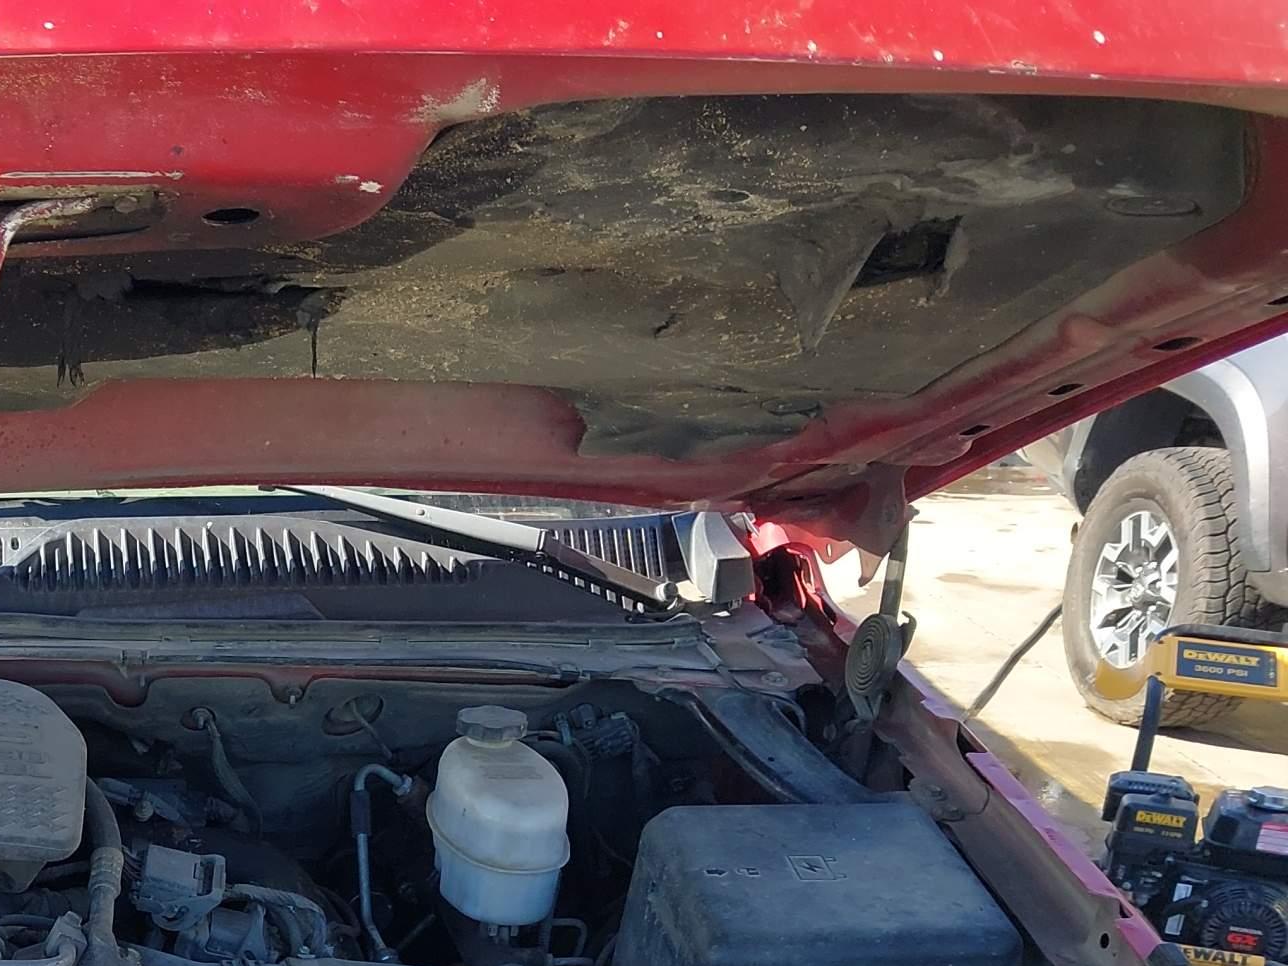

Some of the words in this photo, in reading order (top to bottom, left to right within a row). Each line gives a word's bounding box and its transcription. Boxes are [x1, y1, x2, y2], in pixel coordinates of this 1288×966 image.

[1183, 648, 1261, 668] DEWALT
[1227, 667, 1249, 678] PSI
[1135, 809, 1187, 829] DEWALT
